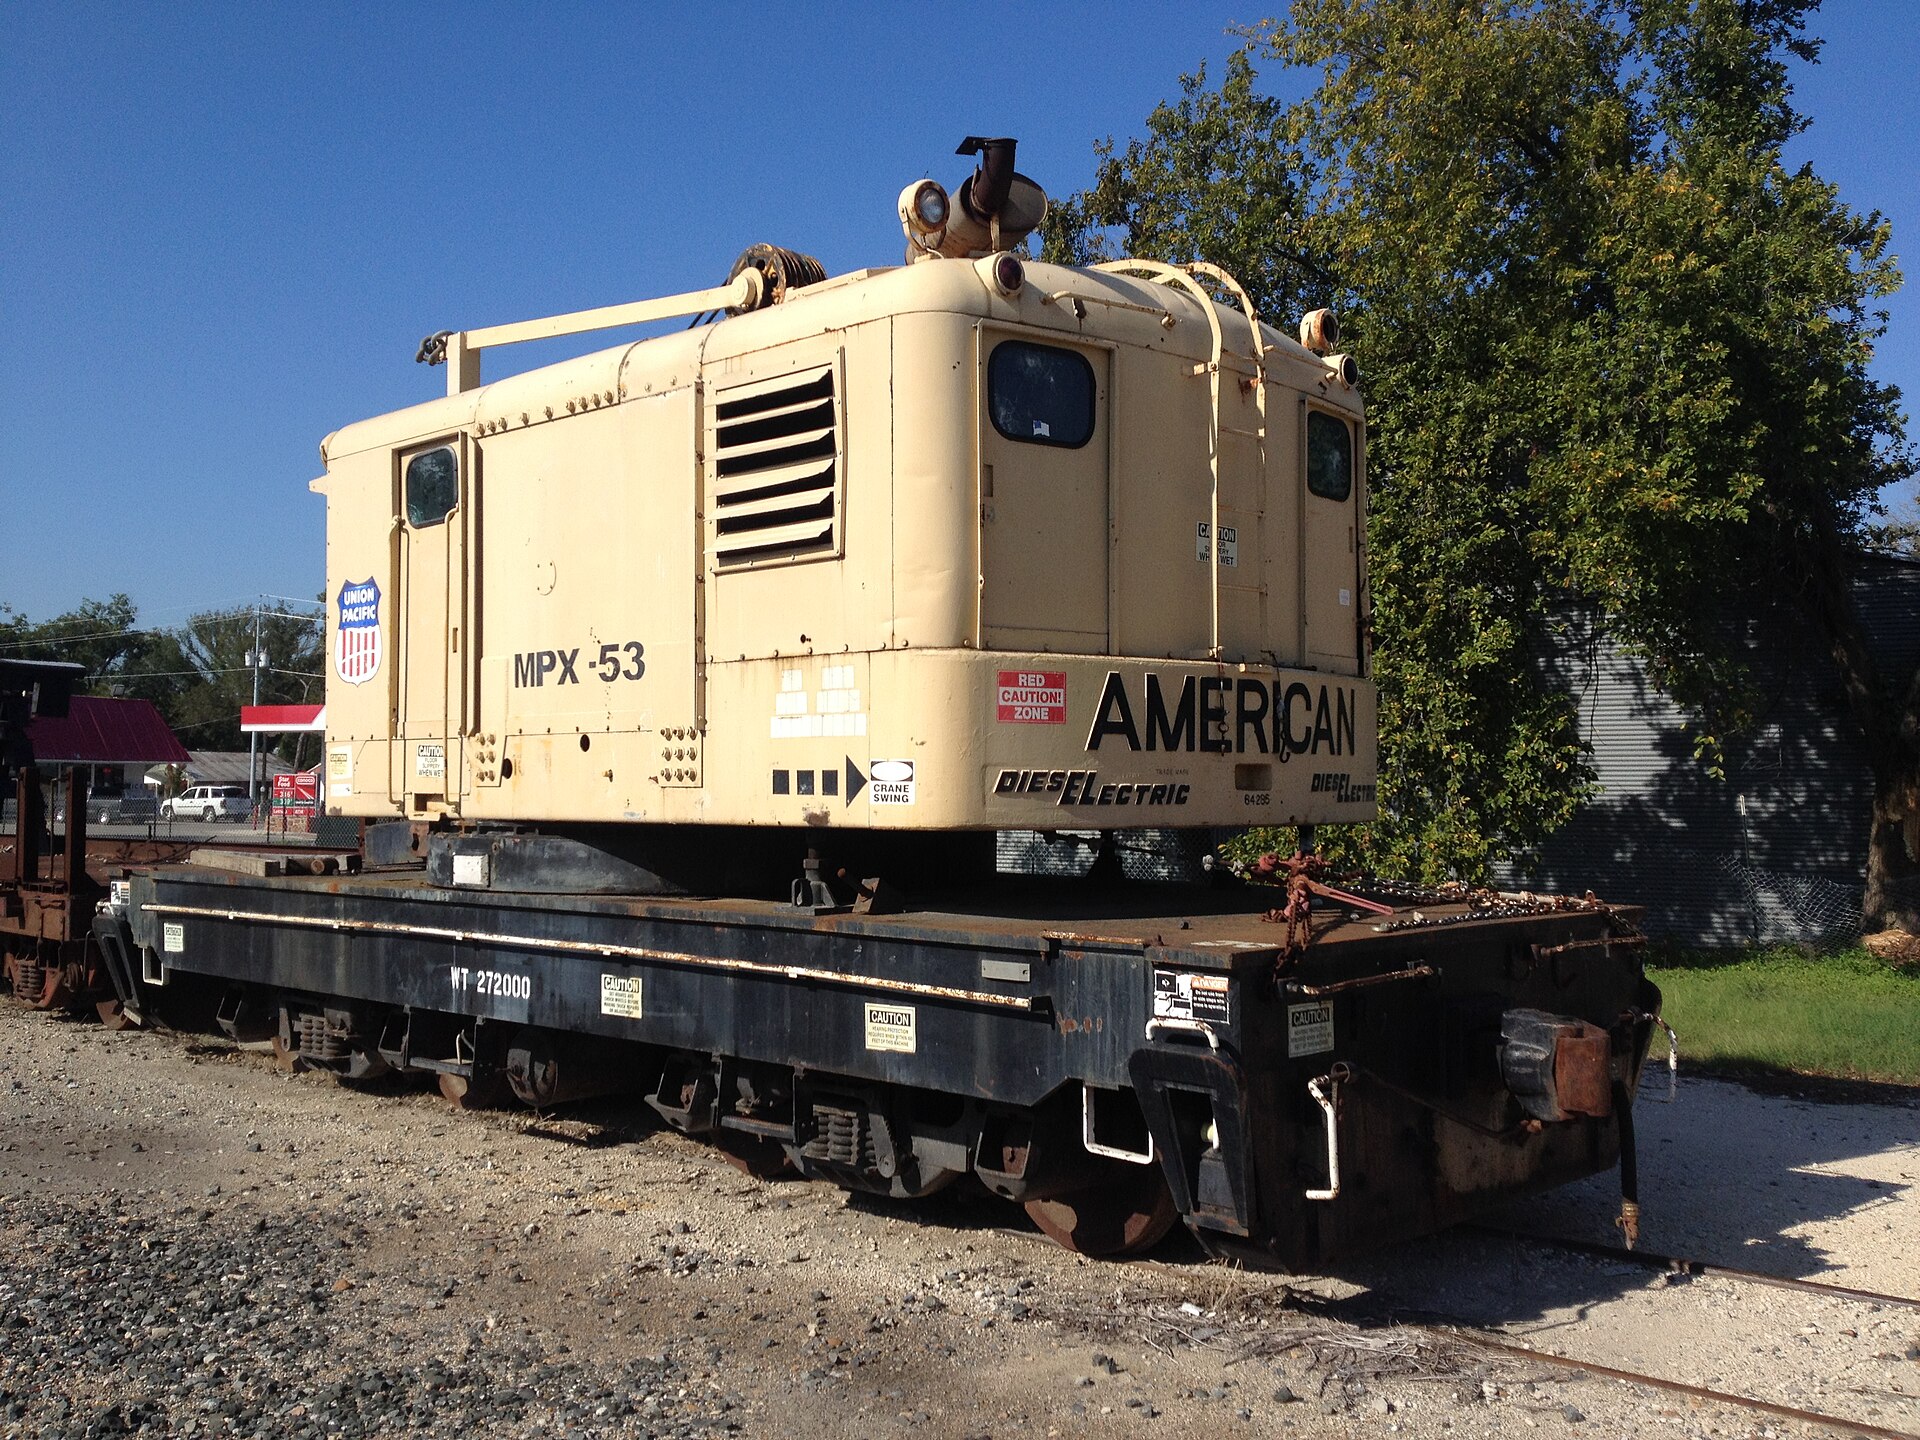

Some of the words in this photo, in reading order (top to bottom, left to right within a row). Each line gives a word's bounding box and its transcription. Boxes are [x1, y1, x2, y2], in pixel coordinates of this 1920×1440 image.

[1199, 524, 1235, 541] CATION
[1220, 556, 1234, 565] WET
[343, 587, 375, 606] UNION
[342, 604, 376, 623] PACIFIC
[514, 648, 580, 688] MPX
[1018, 673, 1045, 687] RED
[1001, 689, 1062, 704] CAUTION!
[1013, 706, 1050, 721] ZONE
[1084, 671, 1356, 756] AMERICAN
[873, 783, 910, 793] CRANE
[873, 793, 909, 803] SWING
[450, 966, 469, 991] WT
[476, 970, 531, 1000] 272000
[604, 977, 639, 993] CAUTION
[1200, 979, 1227, 989] DANGER
[871, 1010, 909, 1026] CAUTION
[1293, 1009, 1328, 1025] CAUTION
